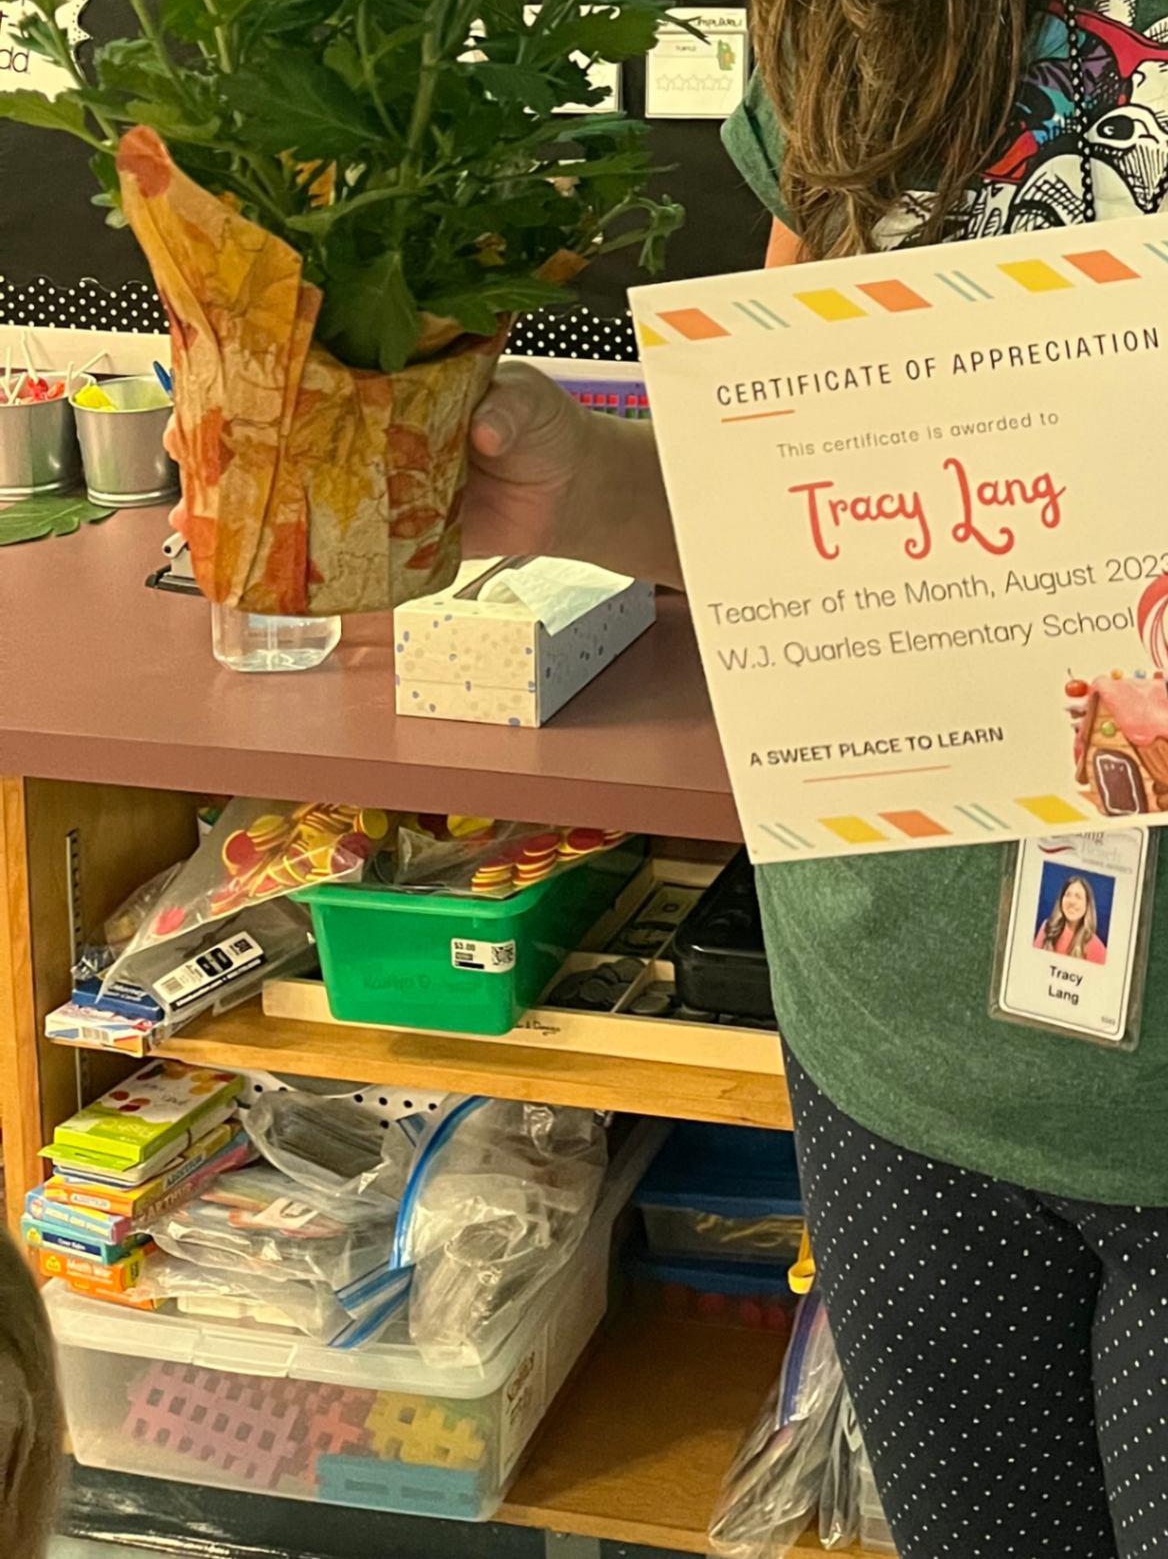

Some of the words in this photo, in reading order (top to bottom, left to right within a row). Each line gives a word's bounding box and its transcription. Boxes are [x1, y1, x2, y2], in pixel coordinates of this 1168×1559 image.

[716, 364, 892, 406] CERTIFICATE
[906, 358, 937, 381] OF
[952, 327, 1161, 375] APPRECIATION
[777, 441, 815, 459] This
[822, 428, 920, 455] certificate
[927, 424, 943, 440] is
[950, 413, 1032, 438] awarded
[1040, 411, 1060, 427] to
[788, 480, 932, 561] Tracy
[942, 457, 1067, 556] Lang
[707, 594, 811, 626] Teacher
[821, 590, 846, 615] of
[854, 586, 897, 611] the
[904, 570, 996, 605] Month,
[1004, 562, 1098, 596] August
[717, 647, 776, 672] W.J.
[783, 635, 882, 670] Quarles
[889, 620, 1034, 653] Elementary
[1042, 607, 1136, 637] School
[749, 752, 763, 768] A
[766, 744, 832, 766] SWEET
[839, 737, 902, 760] PLACE
[906, 734, 934, 753] TO
[937, 726, 1005, 749] LEARN
[1048, 985, 1080, 1005] Lang
[1049, 964, 1083, 987] Tracy
